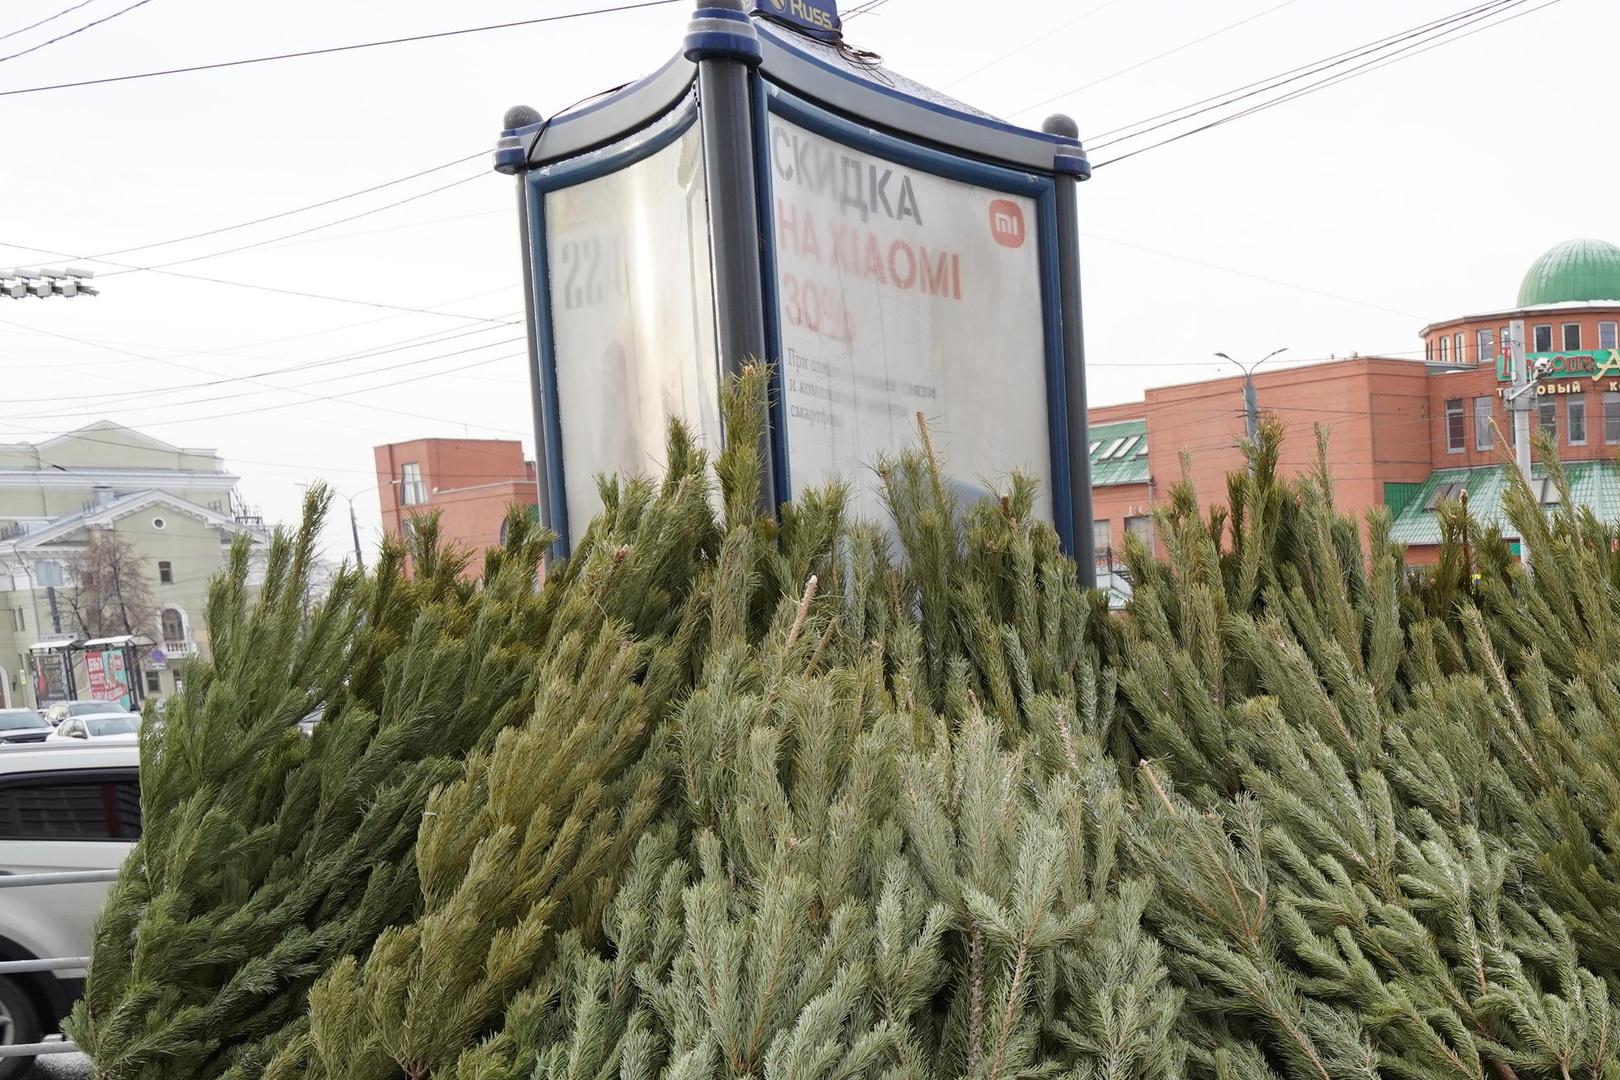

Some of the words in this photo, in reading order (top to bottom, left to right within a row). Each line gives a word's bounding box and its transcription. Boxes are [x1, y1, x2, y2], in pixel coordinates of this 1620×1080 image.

[772, 125, 923, 227] СКИДКА
[777, 197, 823, 266] НА
[787, 347, 809, 373] При
